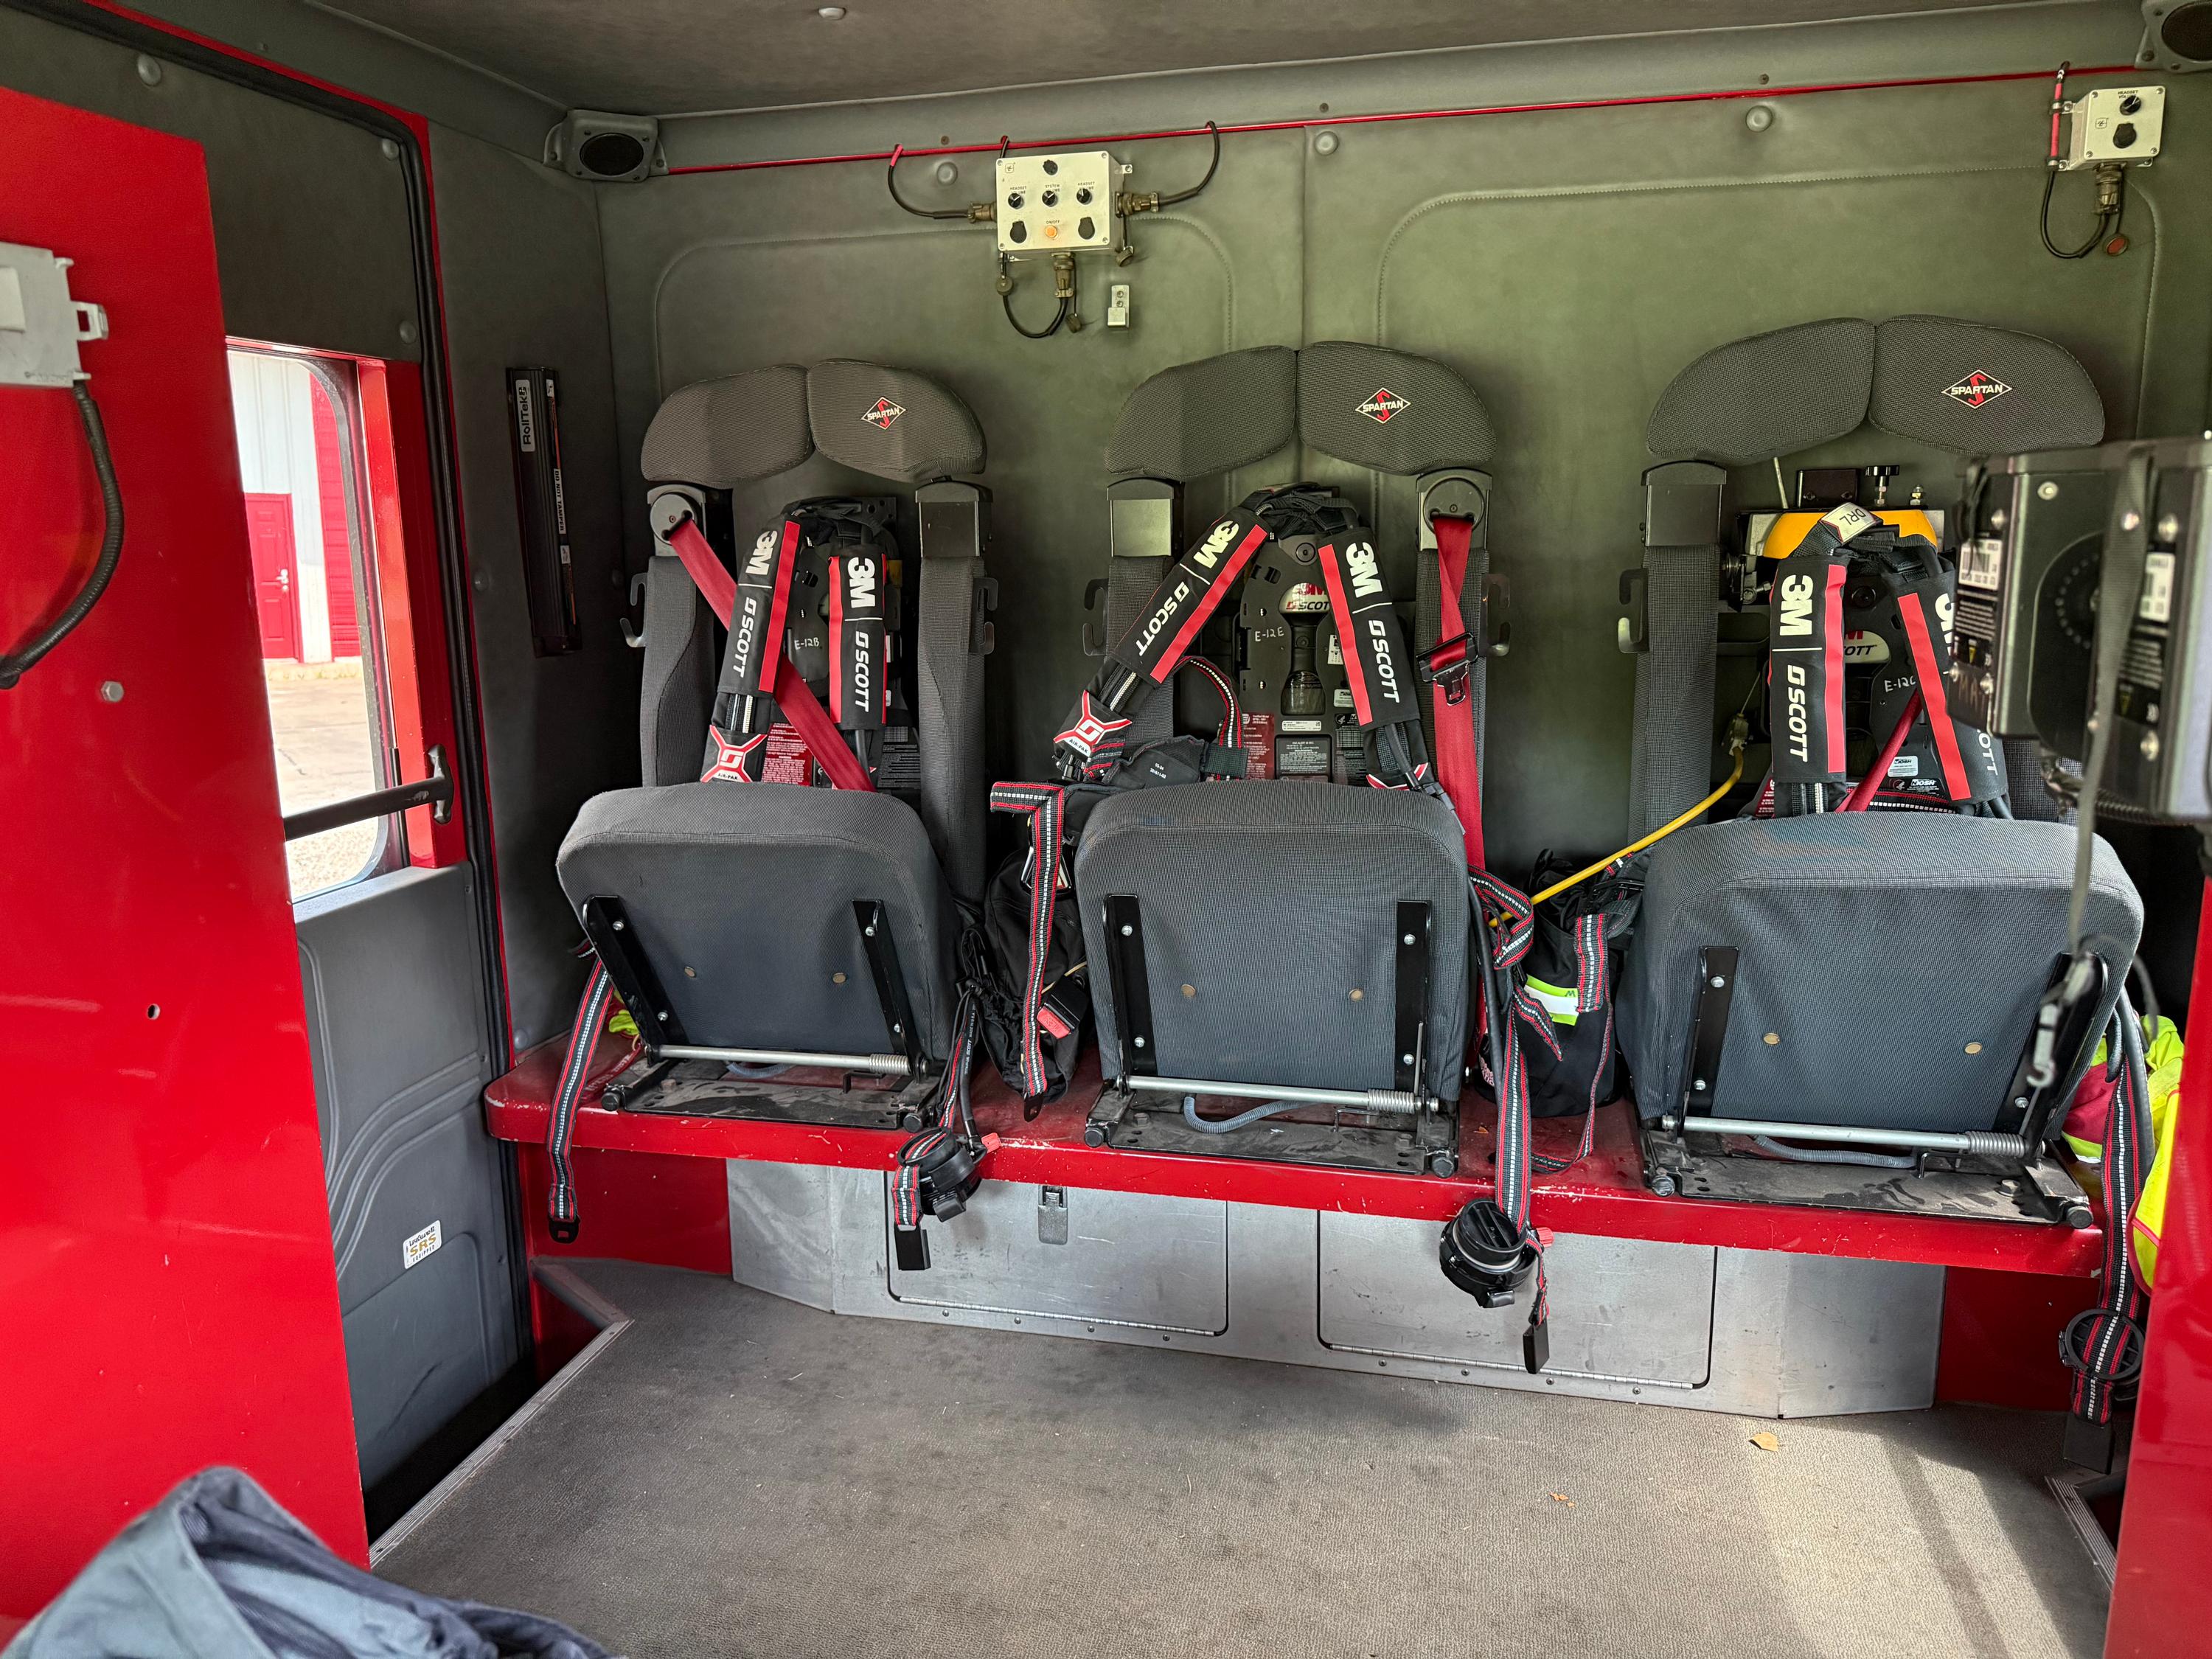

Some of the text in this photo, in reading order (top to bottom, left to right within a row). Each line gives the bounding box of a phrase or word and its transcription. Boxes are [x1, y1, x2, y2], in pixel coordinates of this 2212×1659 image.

[1950, 384, 2003, 395] SPARTAN
[867, 407, 900, 421] SPARTAN
[1363, 400, 1404, 413] SPARTAN
[519, 395, 532, 445] RollTek
[554, 470, 560, 481] DO
[1839, 508, 1866, 525] DRL
[1135, 521, 1239, 656] 3M SCOTT
[733, 530, 778, 678] 3M SCOTT
[1346, 542, 1400, 703] 3M SCOTT
[848, 557, 876, 712] 3M SCOTT
[1255, 627, 1284, 642] E-12E
[794, 637, 820, 650] E-12B
[1779, 574, 1814, 762] 3M SCOTT
[718, 773, 738, 781] AIR-PAK
[410, 1233, 437, 1256] SRS
